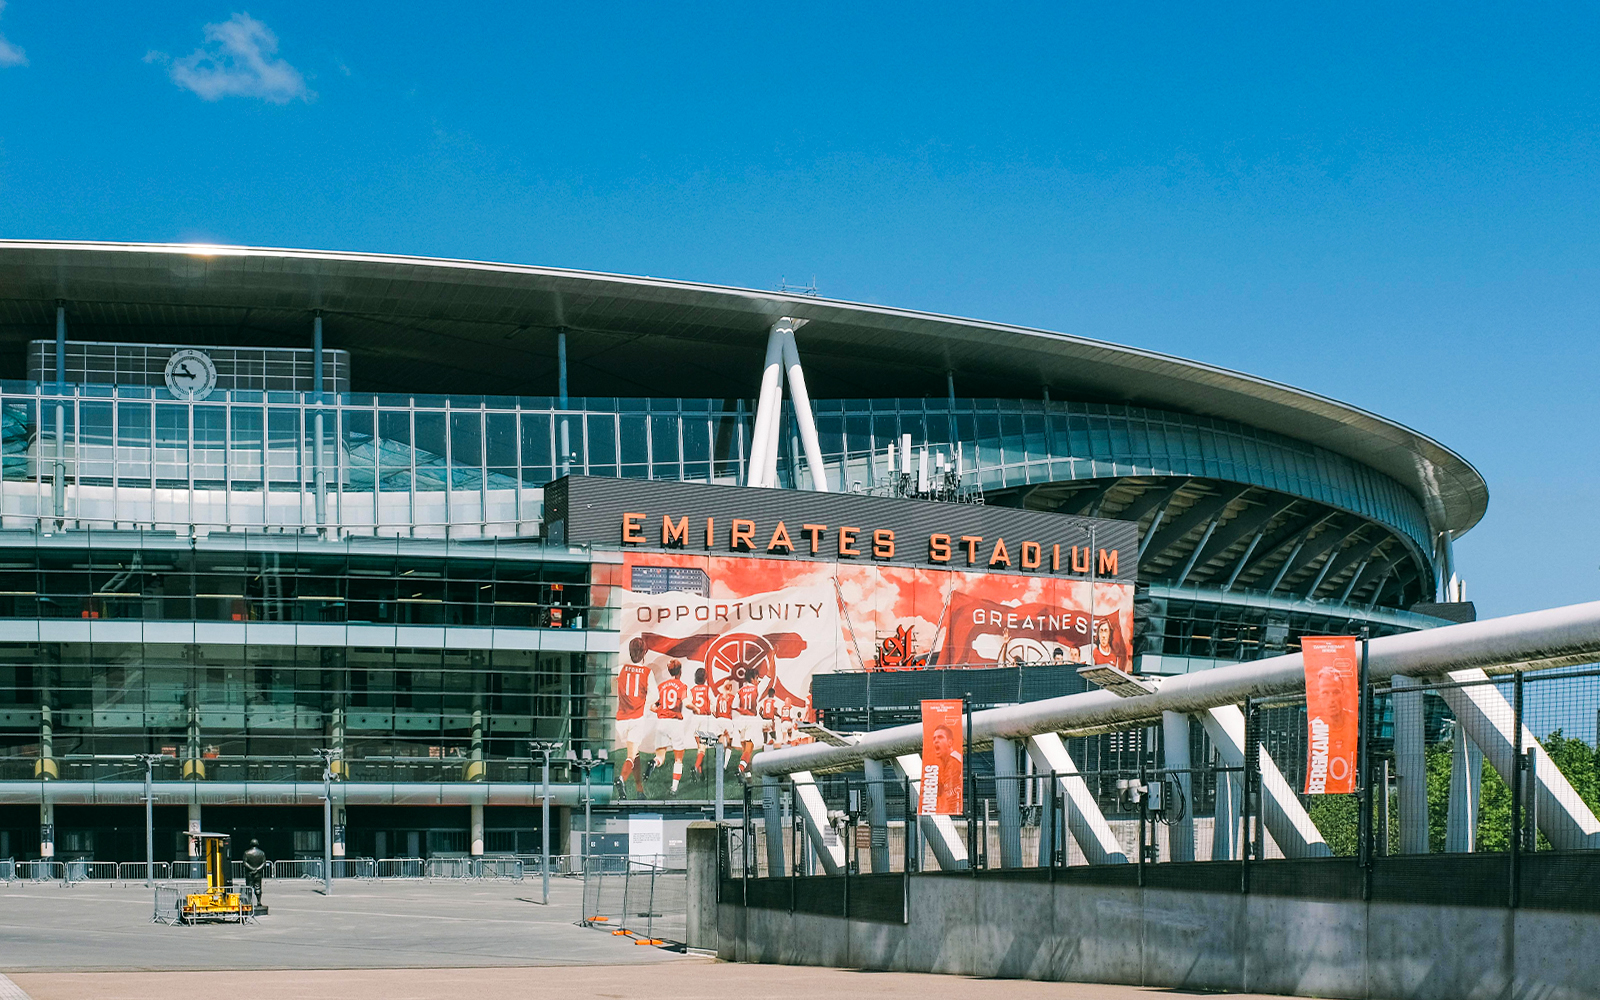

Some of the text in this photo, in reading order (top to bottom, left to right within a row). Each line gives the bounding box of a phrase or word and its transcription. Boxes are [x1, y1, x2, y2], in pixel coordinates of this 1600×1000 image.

[621, 512, 1119, 577] EMIRATES STADIUM
[636, 602, 824, 624] OPPORTUNITY
[625, 673, 640, 697] 11
[662, 689, 678, 710] 19
[695, 692, 705, 707] 5
[743, 693, 752, 710] 11
[1308, 716, 1330, 795] BERGKAMP
[921, 764, 940, 816] FABREGAS
